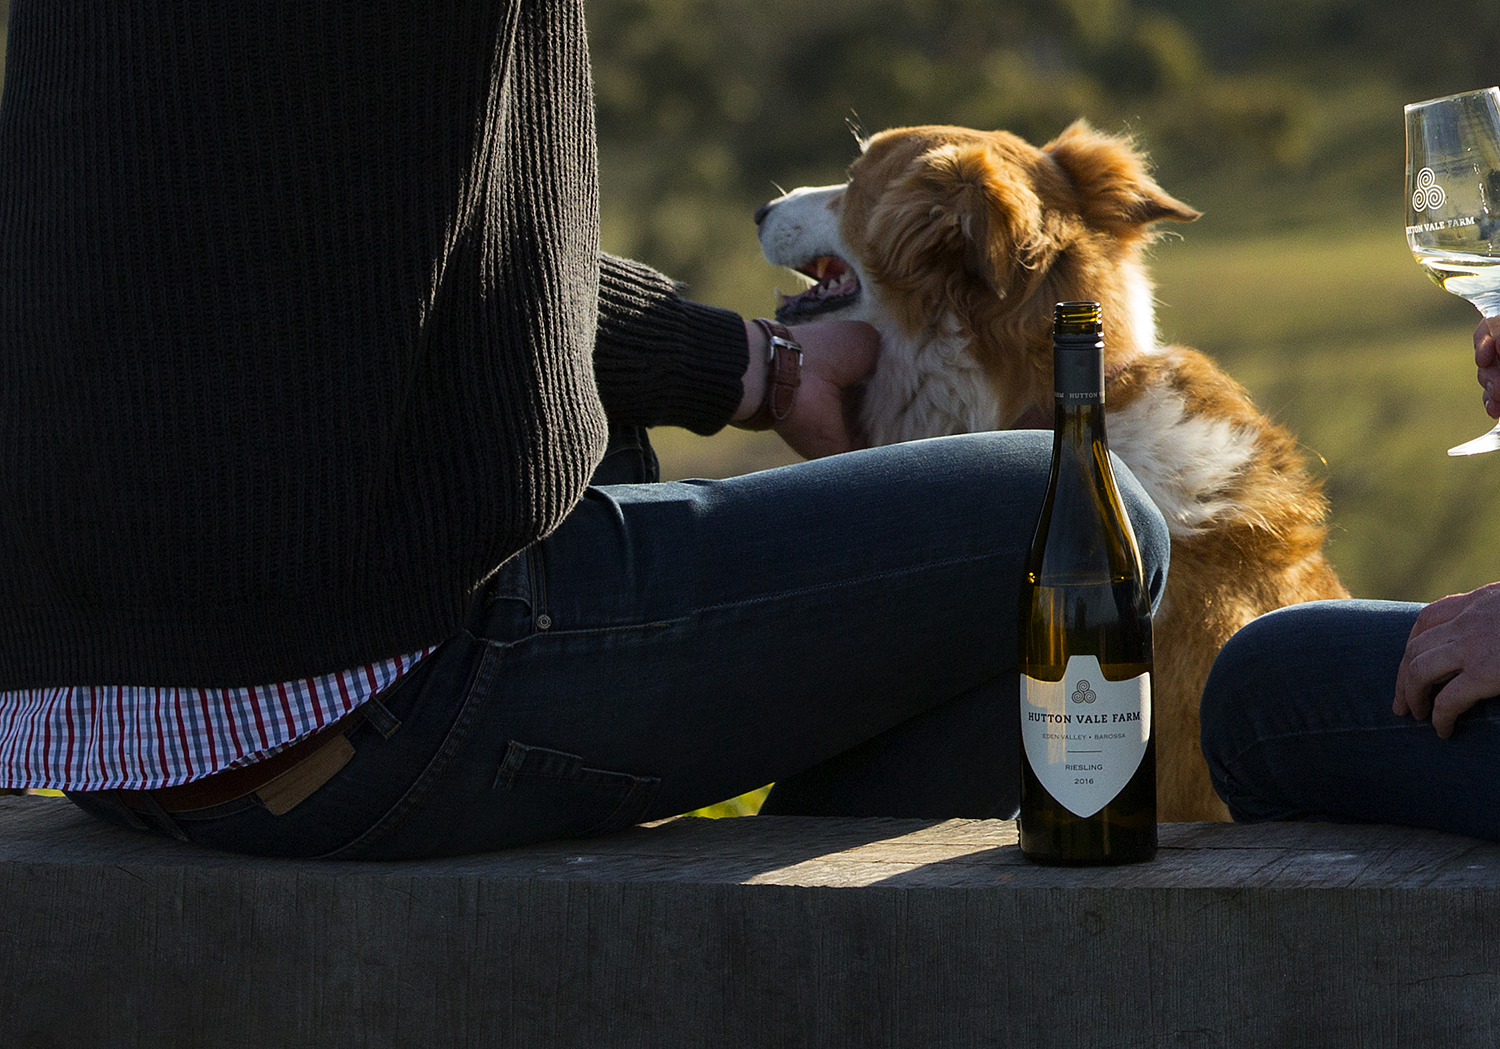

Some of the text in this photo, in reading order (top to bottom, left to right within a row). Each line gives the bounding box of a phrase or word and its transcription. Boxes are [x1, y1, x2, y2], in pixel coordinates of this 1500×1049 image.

[1424, 221, 1445, 232] VALE
[1447, 216, 1475, 228] FARM
[1028, 711, 1141, 723] HUTTON VALE FARM
